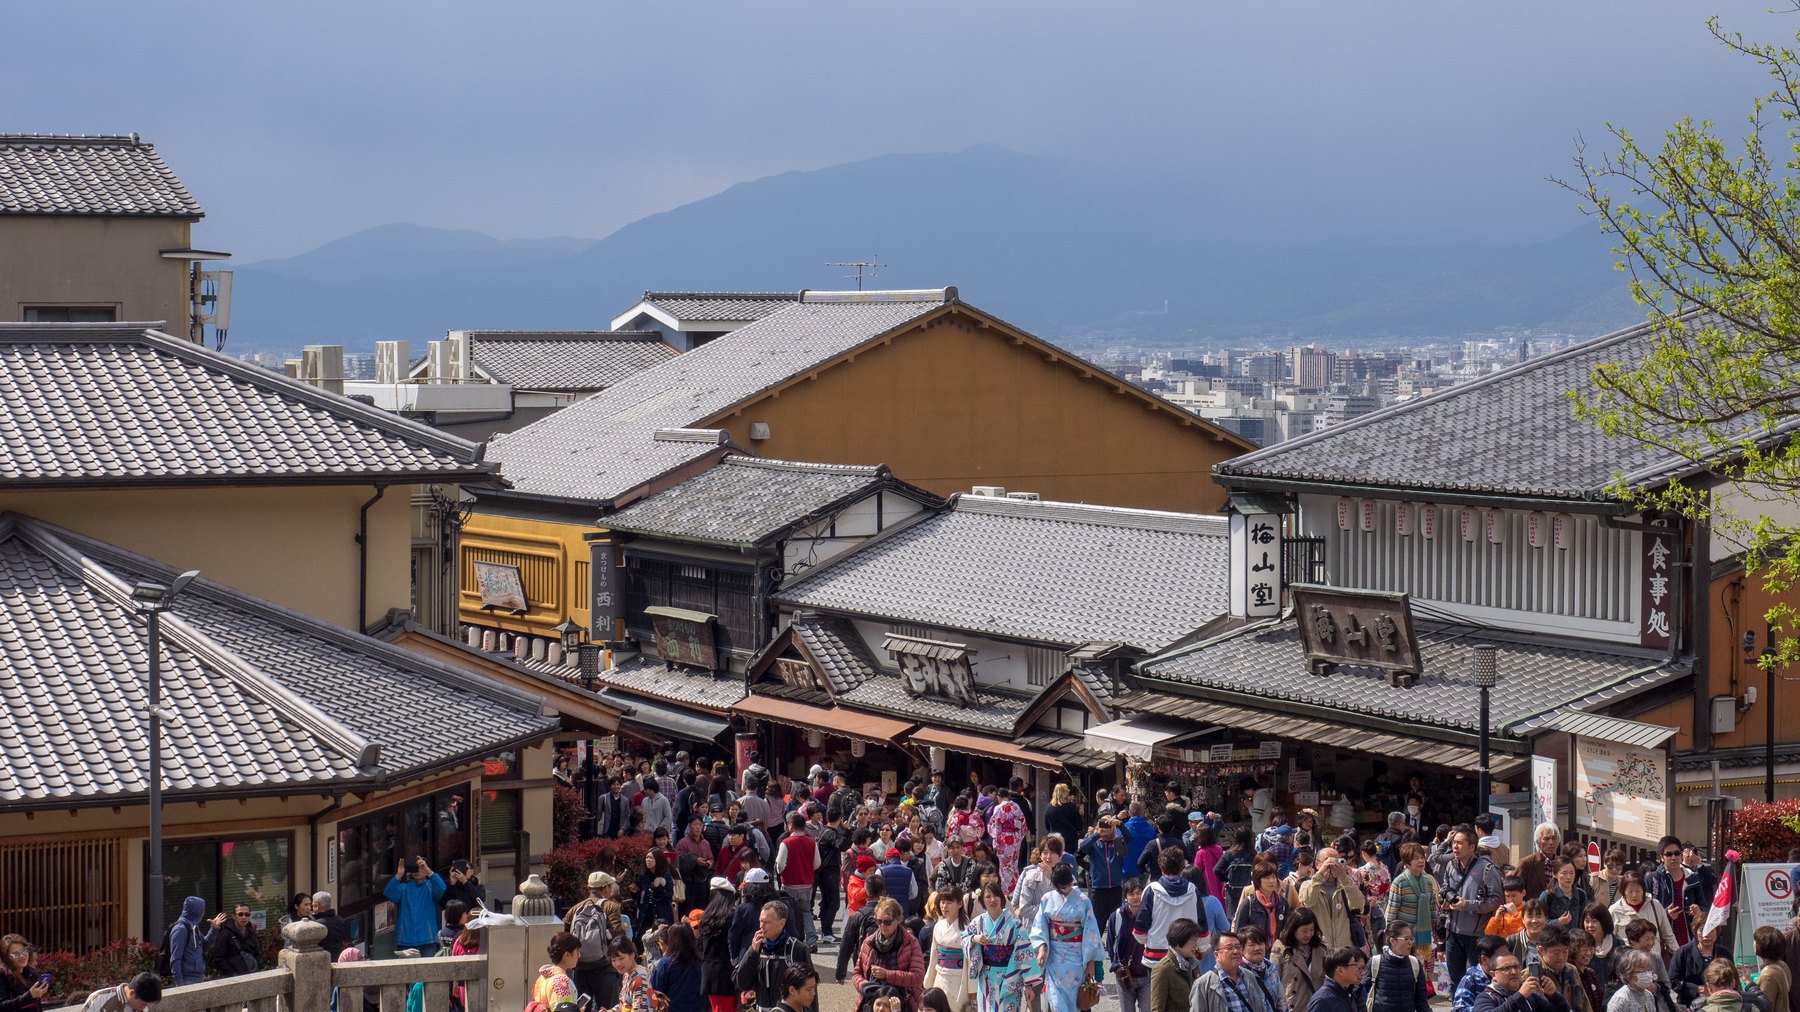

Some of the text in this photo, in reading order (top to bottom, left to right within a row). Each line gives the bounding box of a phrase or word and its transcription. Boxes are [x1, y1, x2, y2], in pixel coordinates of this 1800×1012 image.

[596, 552, 611, 632] 京つけもの 西利
[1251, 523, 1275, 607] 梅山堂
[1311, 604, 1397, 652] 梅山堂
